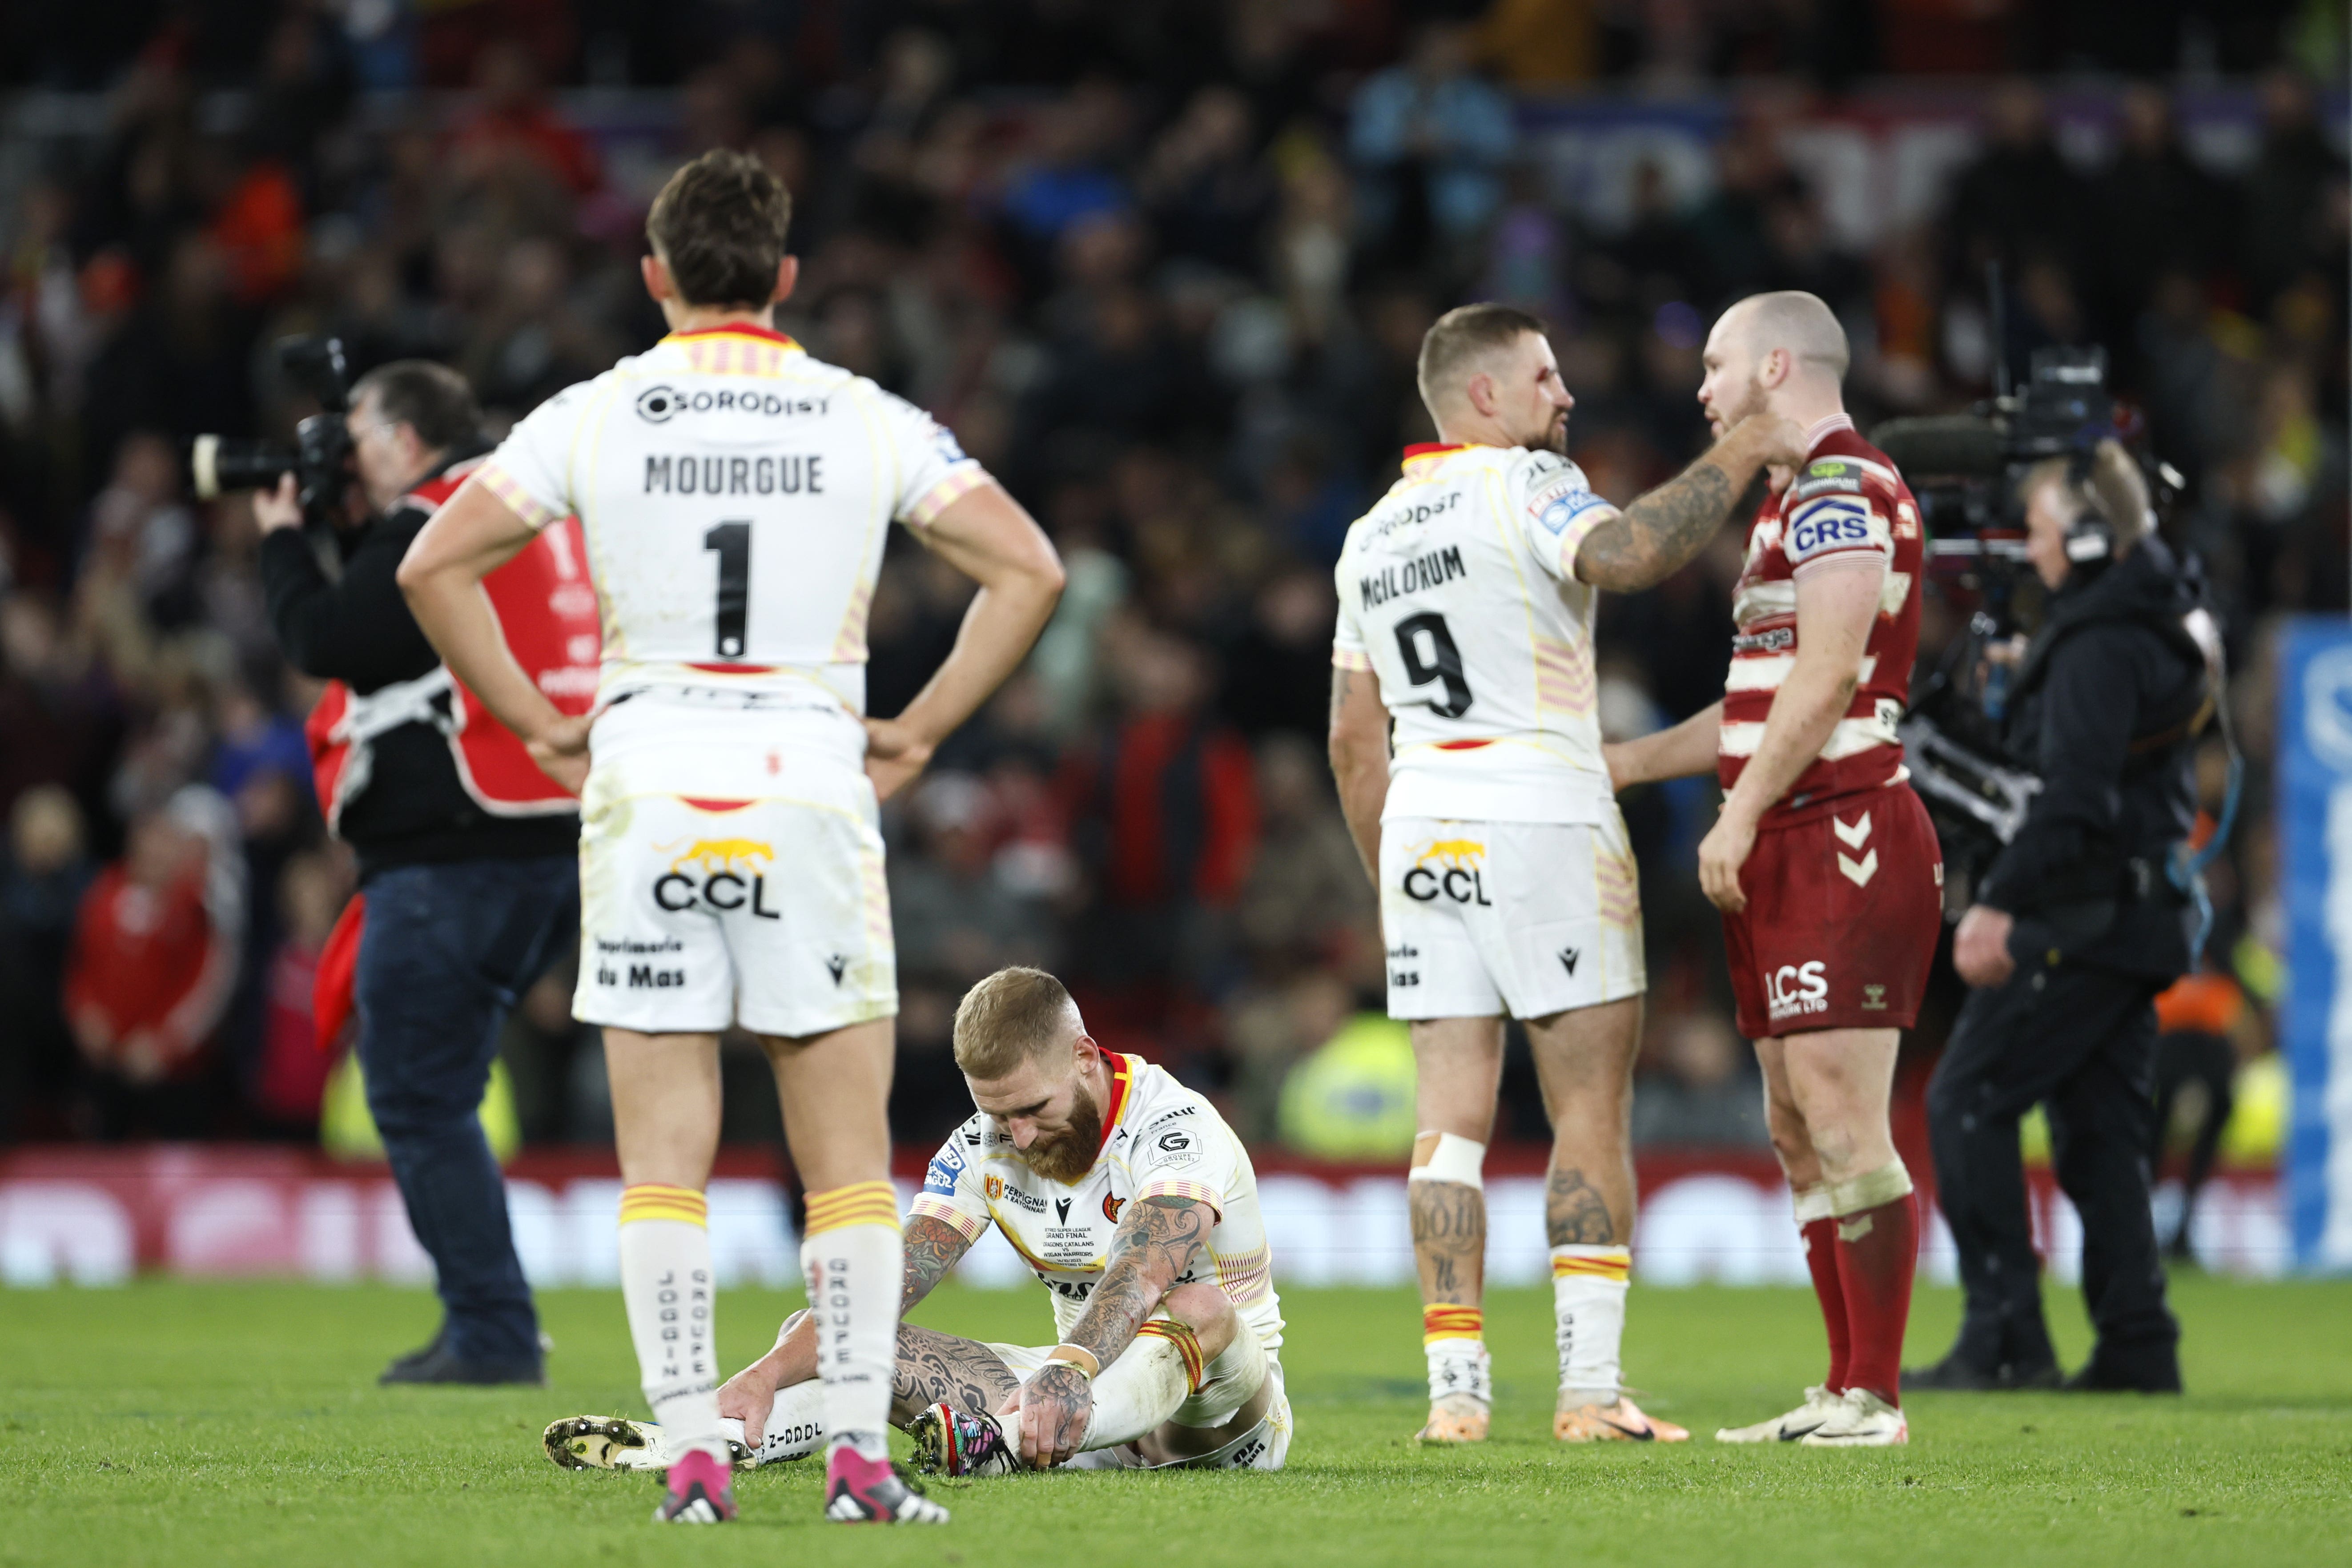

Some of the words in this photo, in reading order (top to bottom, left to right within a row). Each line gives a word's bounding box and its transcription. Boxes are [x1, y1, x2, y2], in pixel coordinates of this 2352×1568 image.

[644, 456, 824, 495] MOURGUE
[1795, 517, 1868, 551] CRS
[704, 519, 752, 660] 1
[1360, 543, 1466, 612] McILORUM
[1393, 608, 1473, 720] 9
[653, 874, 780, 919] CCL
[1403, 868, 1492, 906] CCL
[629, 965, 684, 987] Mas
[1765, 961, 1828, 1008] LCS
[1149, 1106, 1195, 1130] saur
[1151, 1122, 1177, 1134] France
[1010, 1196, 1047, 1214] RAYONNANT
[658, 1270, 679, 1377] JOGGIN
[690, 1270, 708, 1374] GROUPE
[828, 1258, 851, 1364] GROUPE
